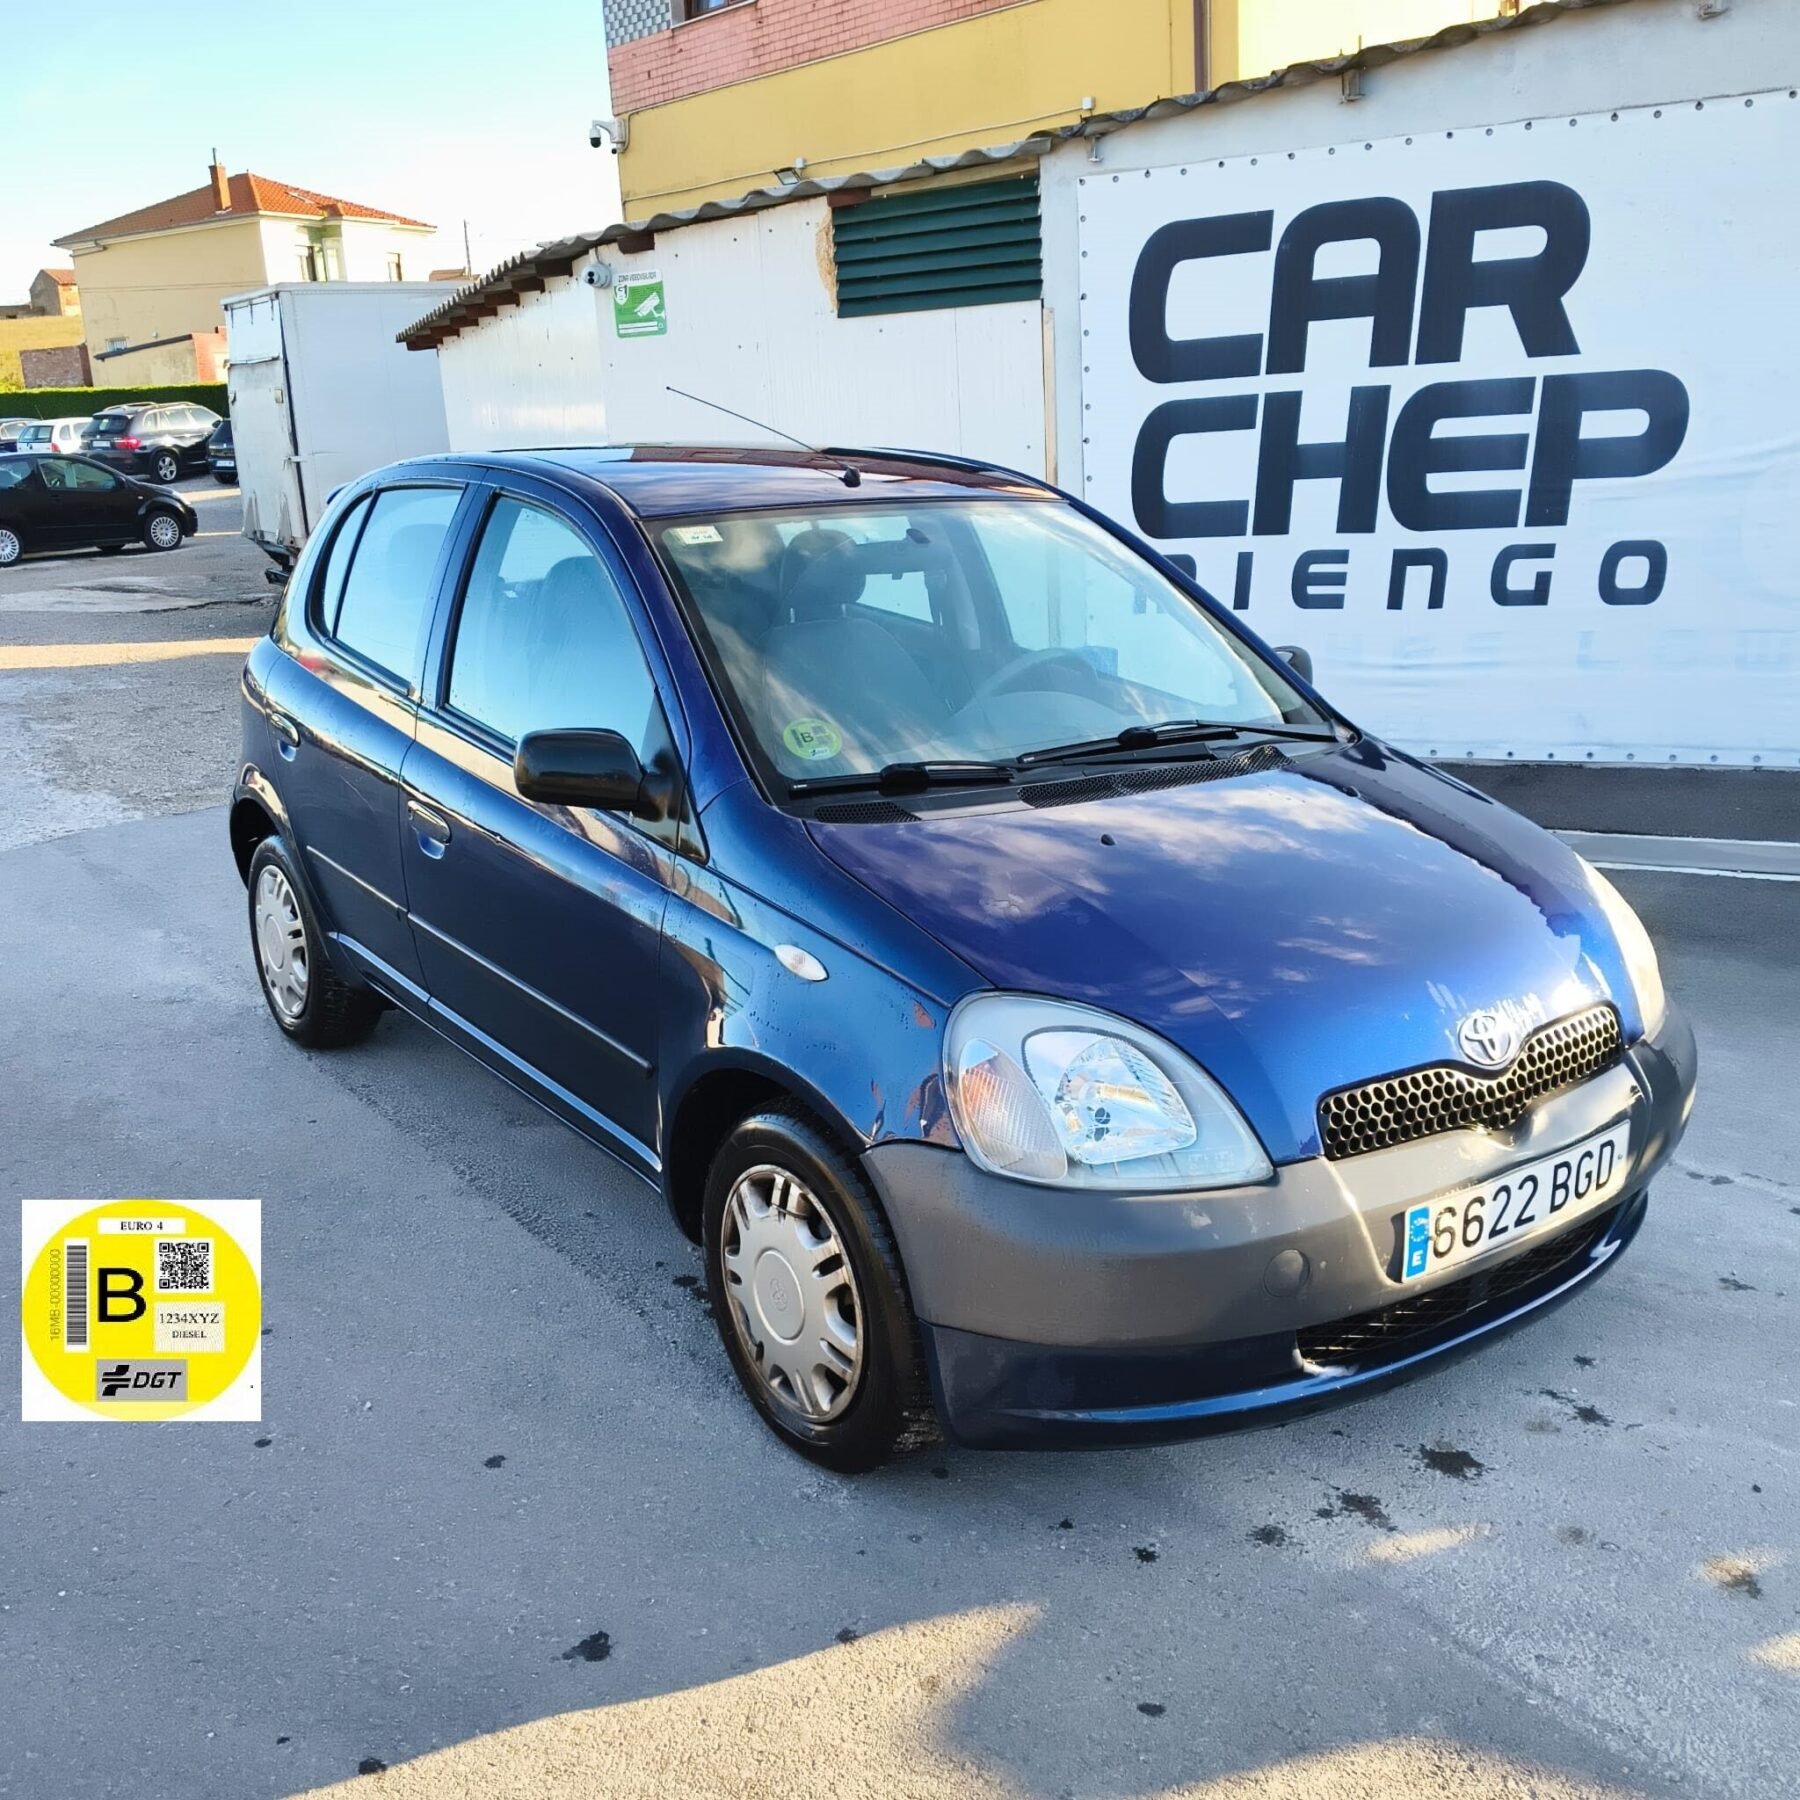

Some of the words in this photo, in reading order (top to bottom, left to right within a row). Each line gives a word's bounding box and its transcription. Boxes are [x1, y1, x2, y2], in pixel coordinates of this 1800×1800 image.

[1129, 180, 1591, 384] CAR
[1130, 368, 1690, 539] CHEP
[800, 732, 813, 743] B
[1412, 1250, 1422, 1265] E
[1433, 1174, 1539, 1258] 6622
[1550, 1139, 1615, 1213] BGD
